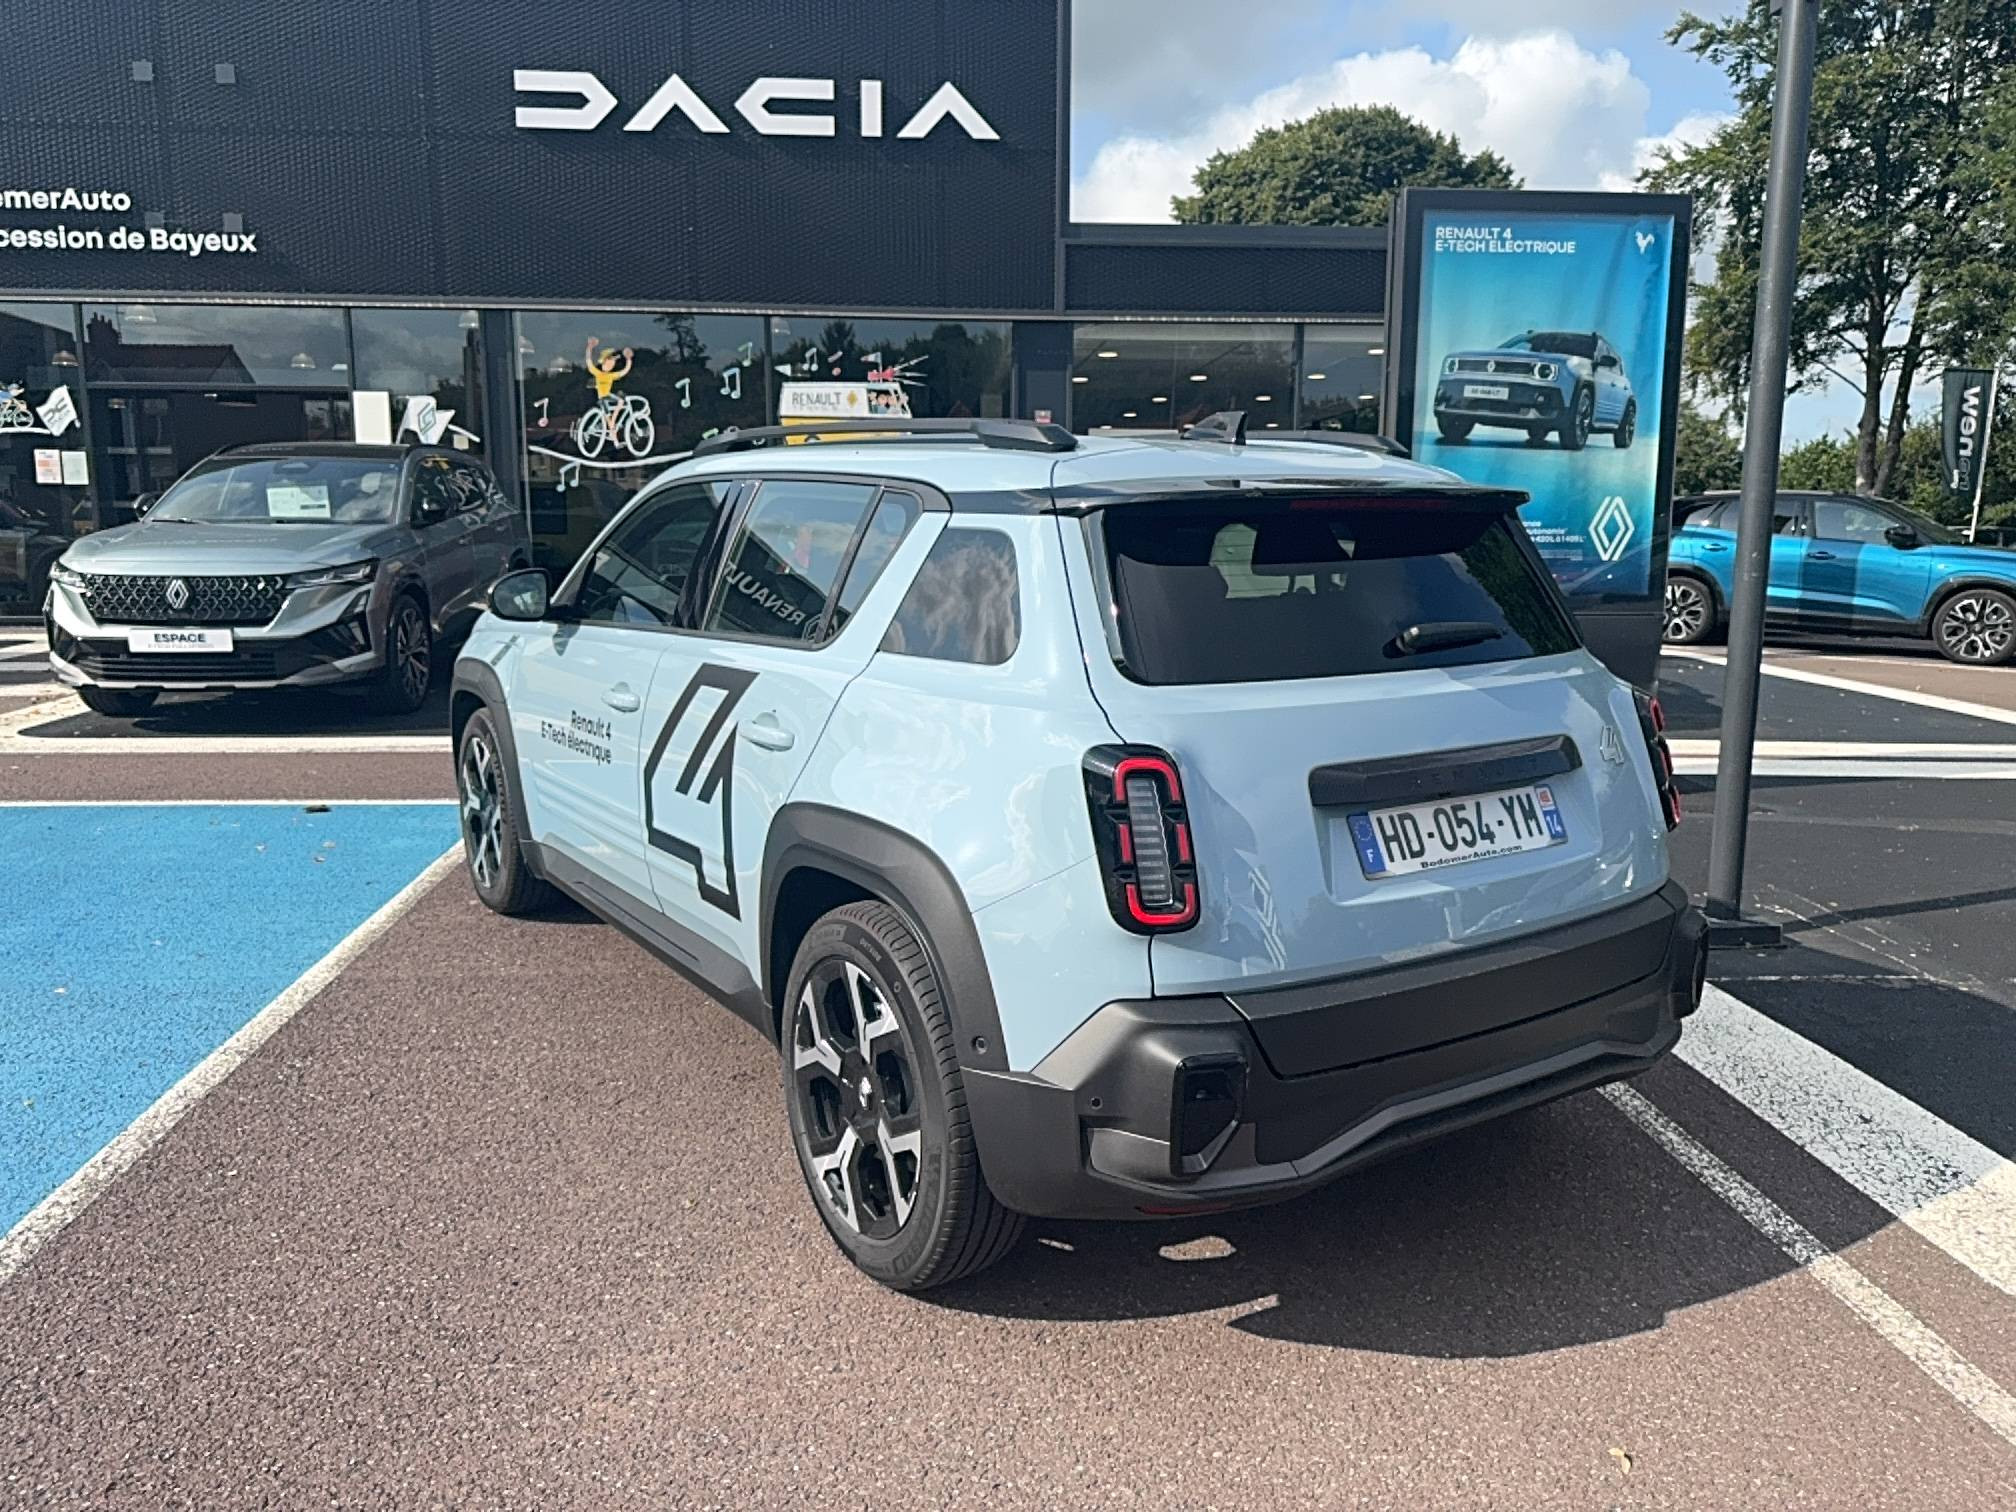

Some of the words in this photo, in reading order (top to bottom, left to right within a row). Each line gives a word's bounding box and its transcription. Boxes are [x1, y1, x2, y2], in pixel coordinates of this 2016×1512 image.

[513, 68, 1000, 140] DACIA
[0, 188, 131, 211] merAuto
[109, 226, 145, 250] de
[149, 228, 257, 257] Bayeux
[1435, 226, 1500, 239] RENAULT
[1502, 227, 1512, 239] 4
[1435, 239, 1485, 253] E-TECH
[791, 391, 842, 406] RENAULT
[153, 633, 206, 643] ESPACE
[571, 709, 604, 739] Renault
[541, 720, 567, 747] E-Tech
[568, 730, 611, 766] électrique
[1546, 811, 1563, 834] 14
[1365, 848, 1374, 863] F
